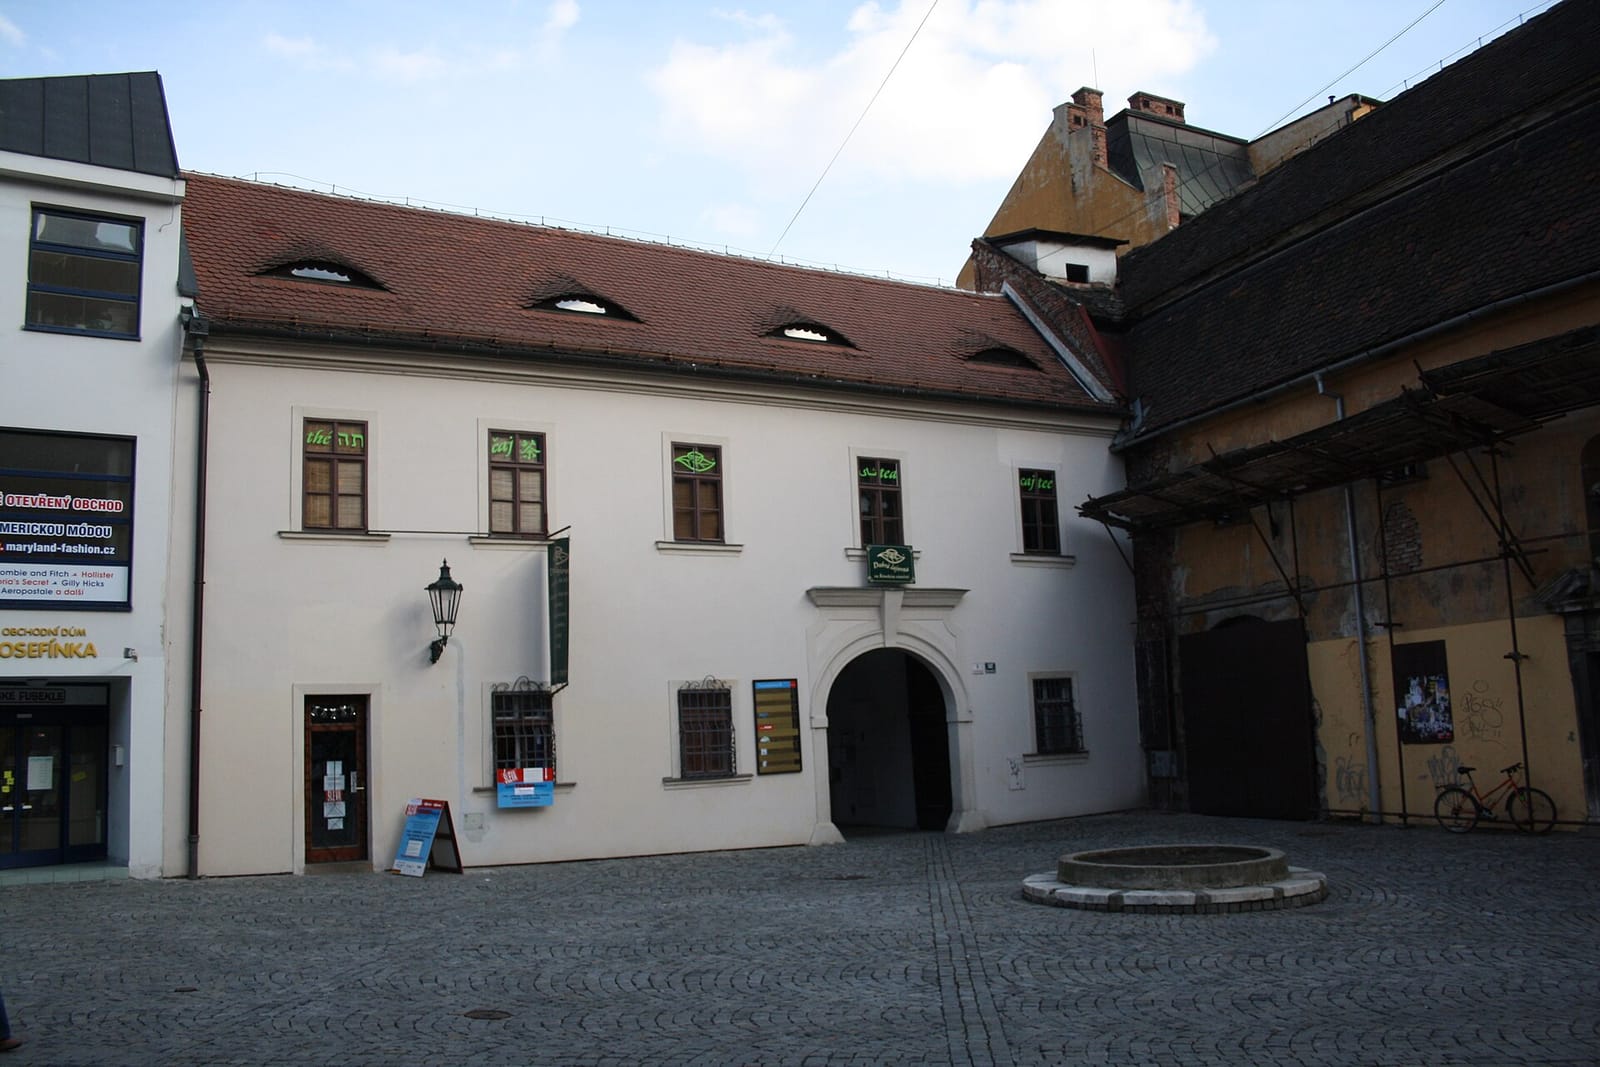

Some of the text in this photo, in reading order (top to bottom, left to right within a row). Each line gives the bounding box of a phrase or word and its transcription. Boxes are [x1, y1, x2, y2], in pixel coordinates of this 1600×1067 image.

[306, 429, 334, 445] thé
[880, 468, 897, 479] tea
[6, 494, 70, 509] OTEVŘENÝ
[73, 499, 123, 512] OBCHOD
[66, 523, 112, 538] MÓDOU
[6, 543, 115, 555] maryland-fashion.cz
[81, 571, 114, 579] Hollister
[22, 578, 49, 586] Secret
[61, 579, 80, 588] Gilly
[1, 587, 53, 596] Aeropostale
[2, 626, 60, 637] OBCHODNÍ
[0, 638, 97, 659] OSEFÍNKA
